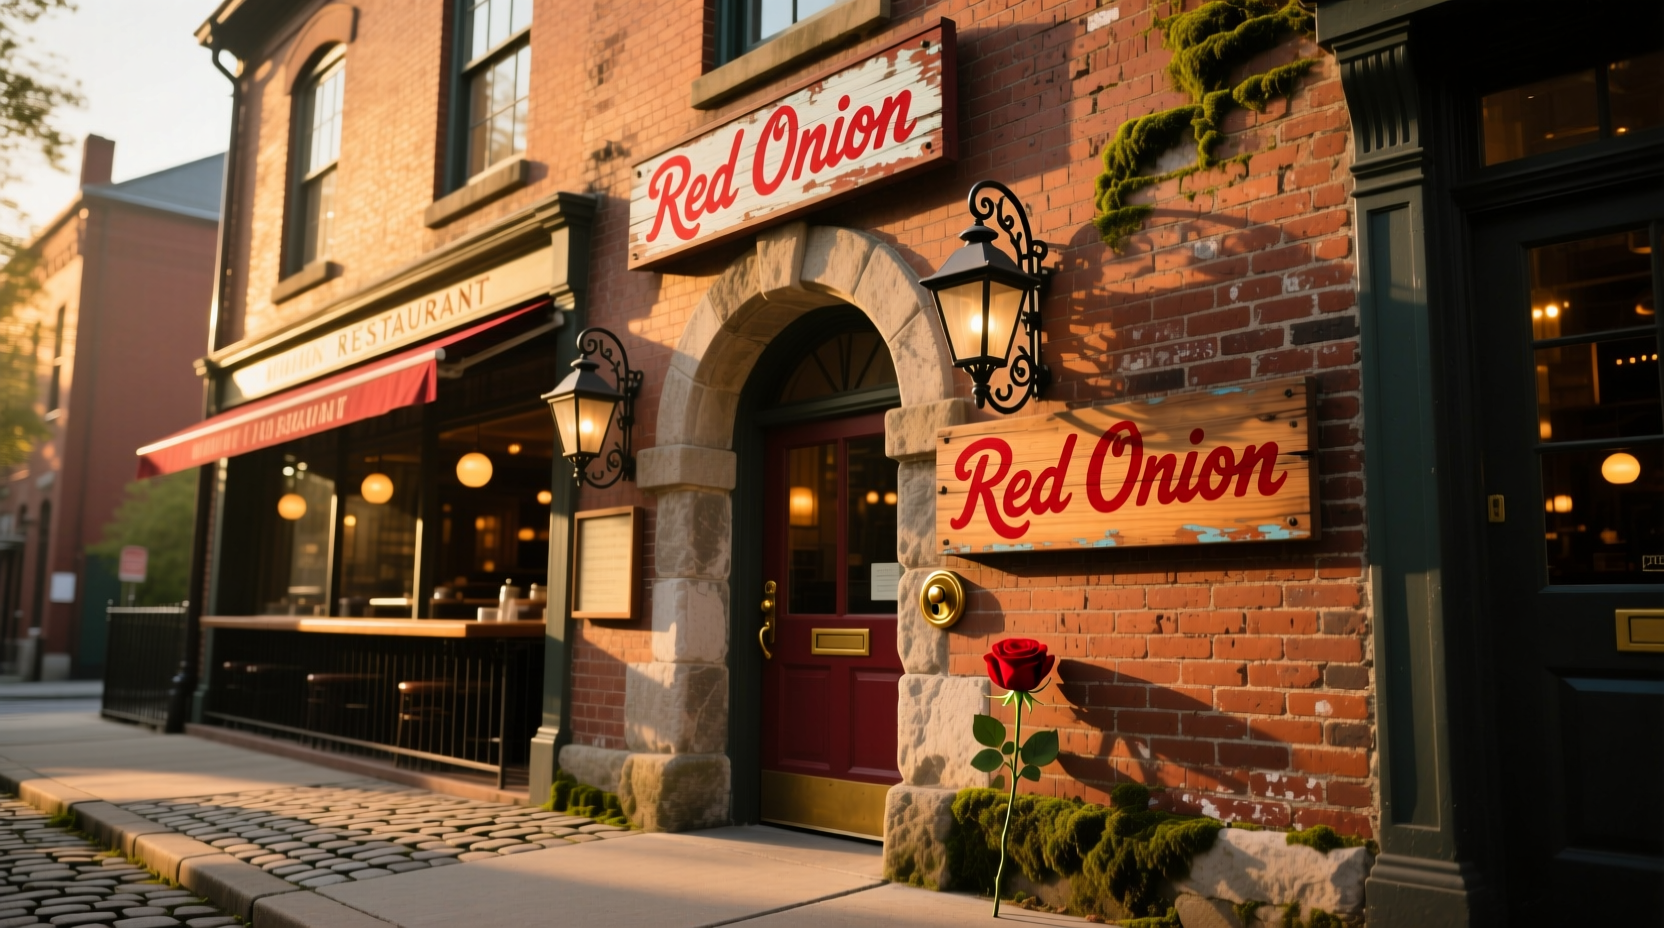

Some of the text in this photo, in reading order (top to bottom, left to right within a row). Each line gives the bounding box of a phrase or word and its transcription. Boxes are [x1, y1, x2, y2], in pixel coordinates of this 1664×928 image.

[646, 89, 917, 242] Red Onion
[337, 276, 490, 358] RESTAURANT
[950, 420, 1287, 540] Red Onion
